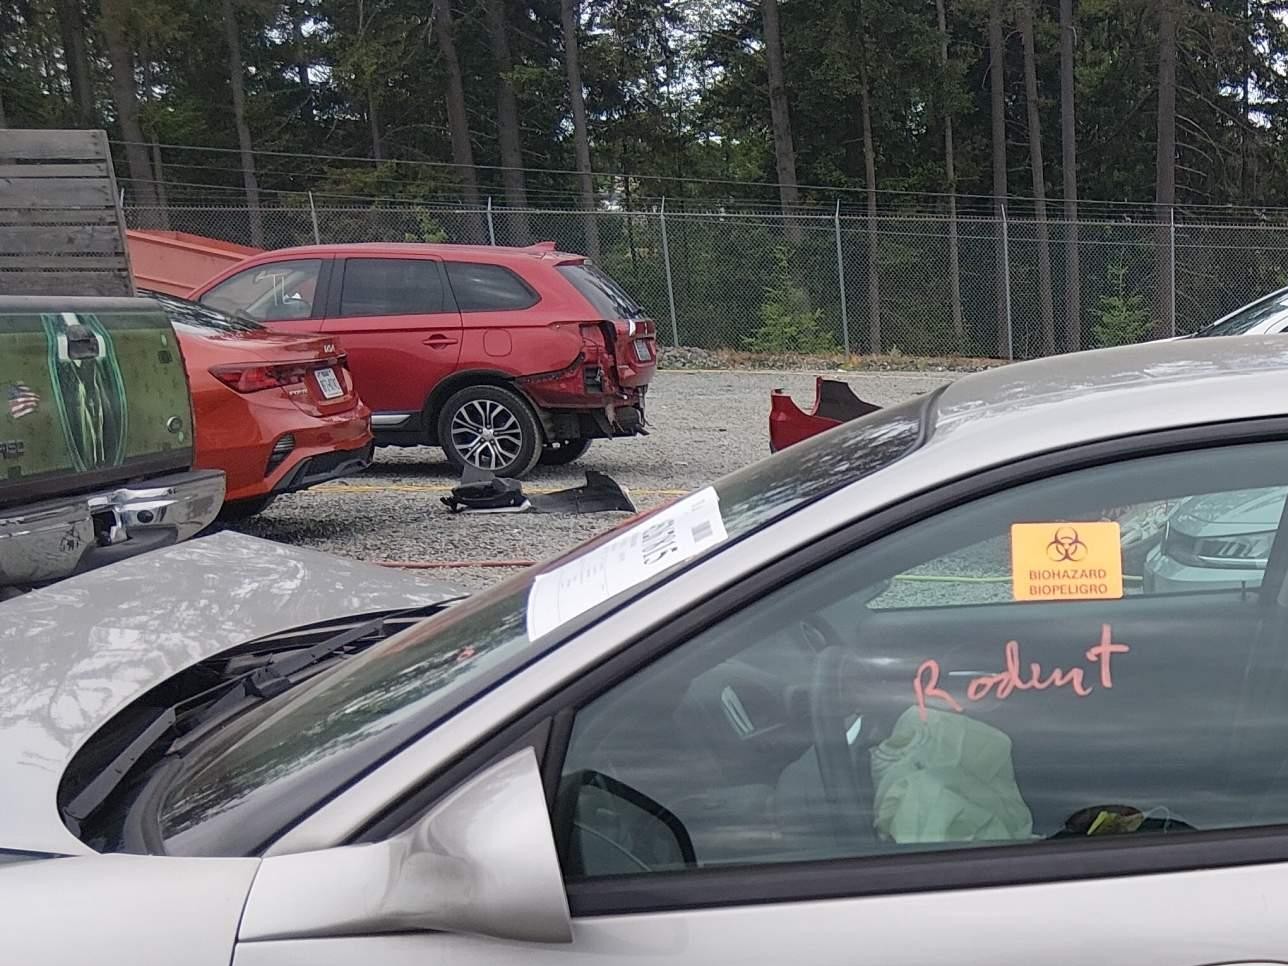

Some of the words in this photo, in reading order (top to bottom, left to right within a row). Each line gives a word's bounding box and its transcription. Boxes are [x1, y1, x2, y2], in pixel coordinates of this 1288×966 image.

[1029, 568, 1107, 580] BIOHAZARD
[1029, 583, 1108, 595] BIOPELIGRO
[913, 623, 1131, 721] Rodent
